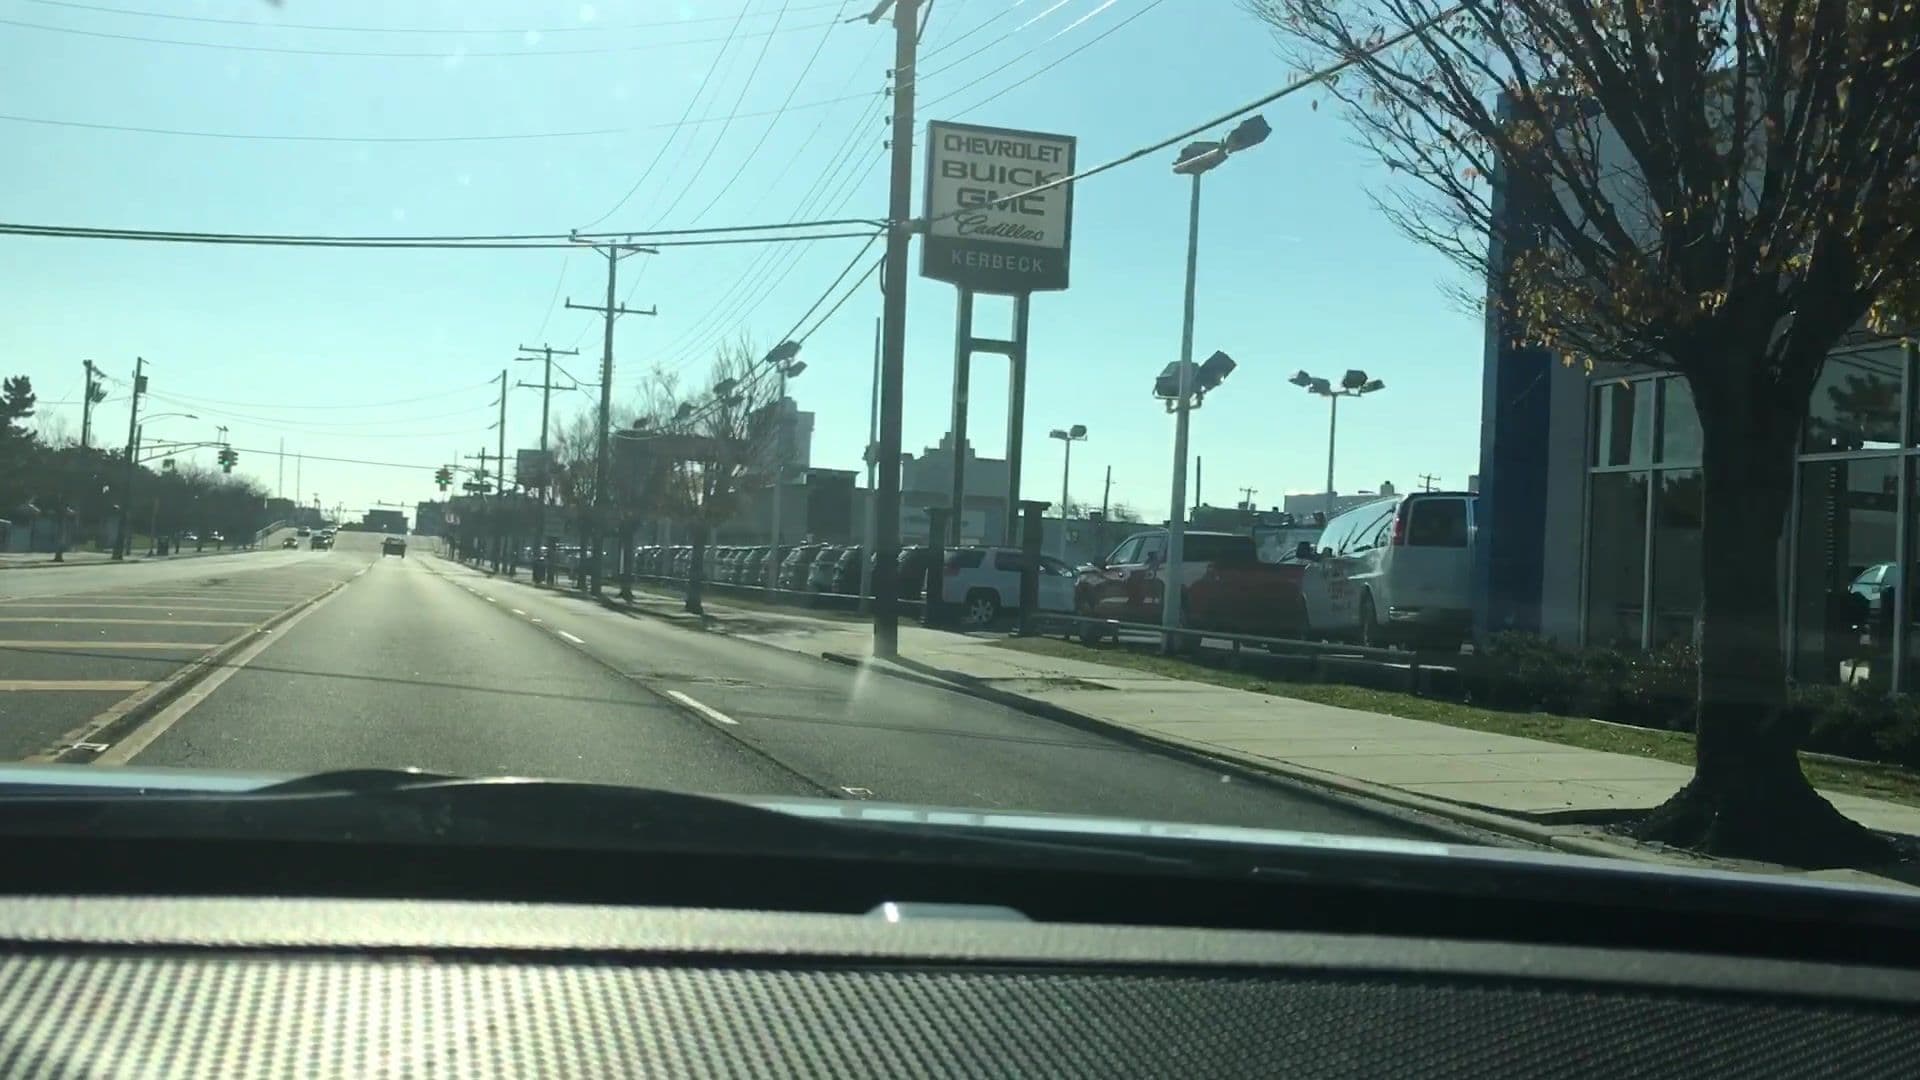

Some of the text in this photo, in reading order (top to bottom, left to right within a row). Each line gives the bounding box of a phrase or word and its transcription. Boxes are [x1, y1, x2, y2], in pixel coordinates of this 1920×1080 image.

[944, 134, 1062, 163] CHEVROLET
[942, 160, 1061, 190] BUICK
[957, 187, 1045, 216] GMC
[954, 209, 1044, 240] Cadillac
[951, 249, 1042, 273] KERBECK
